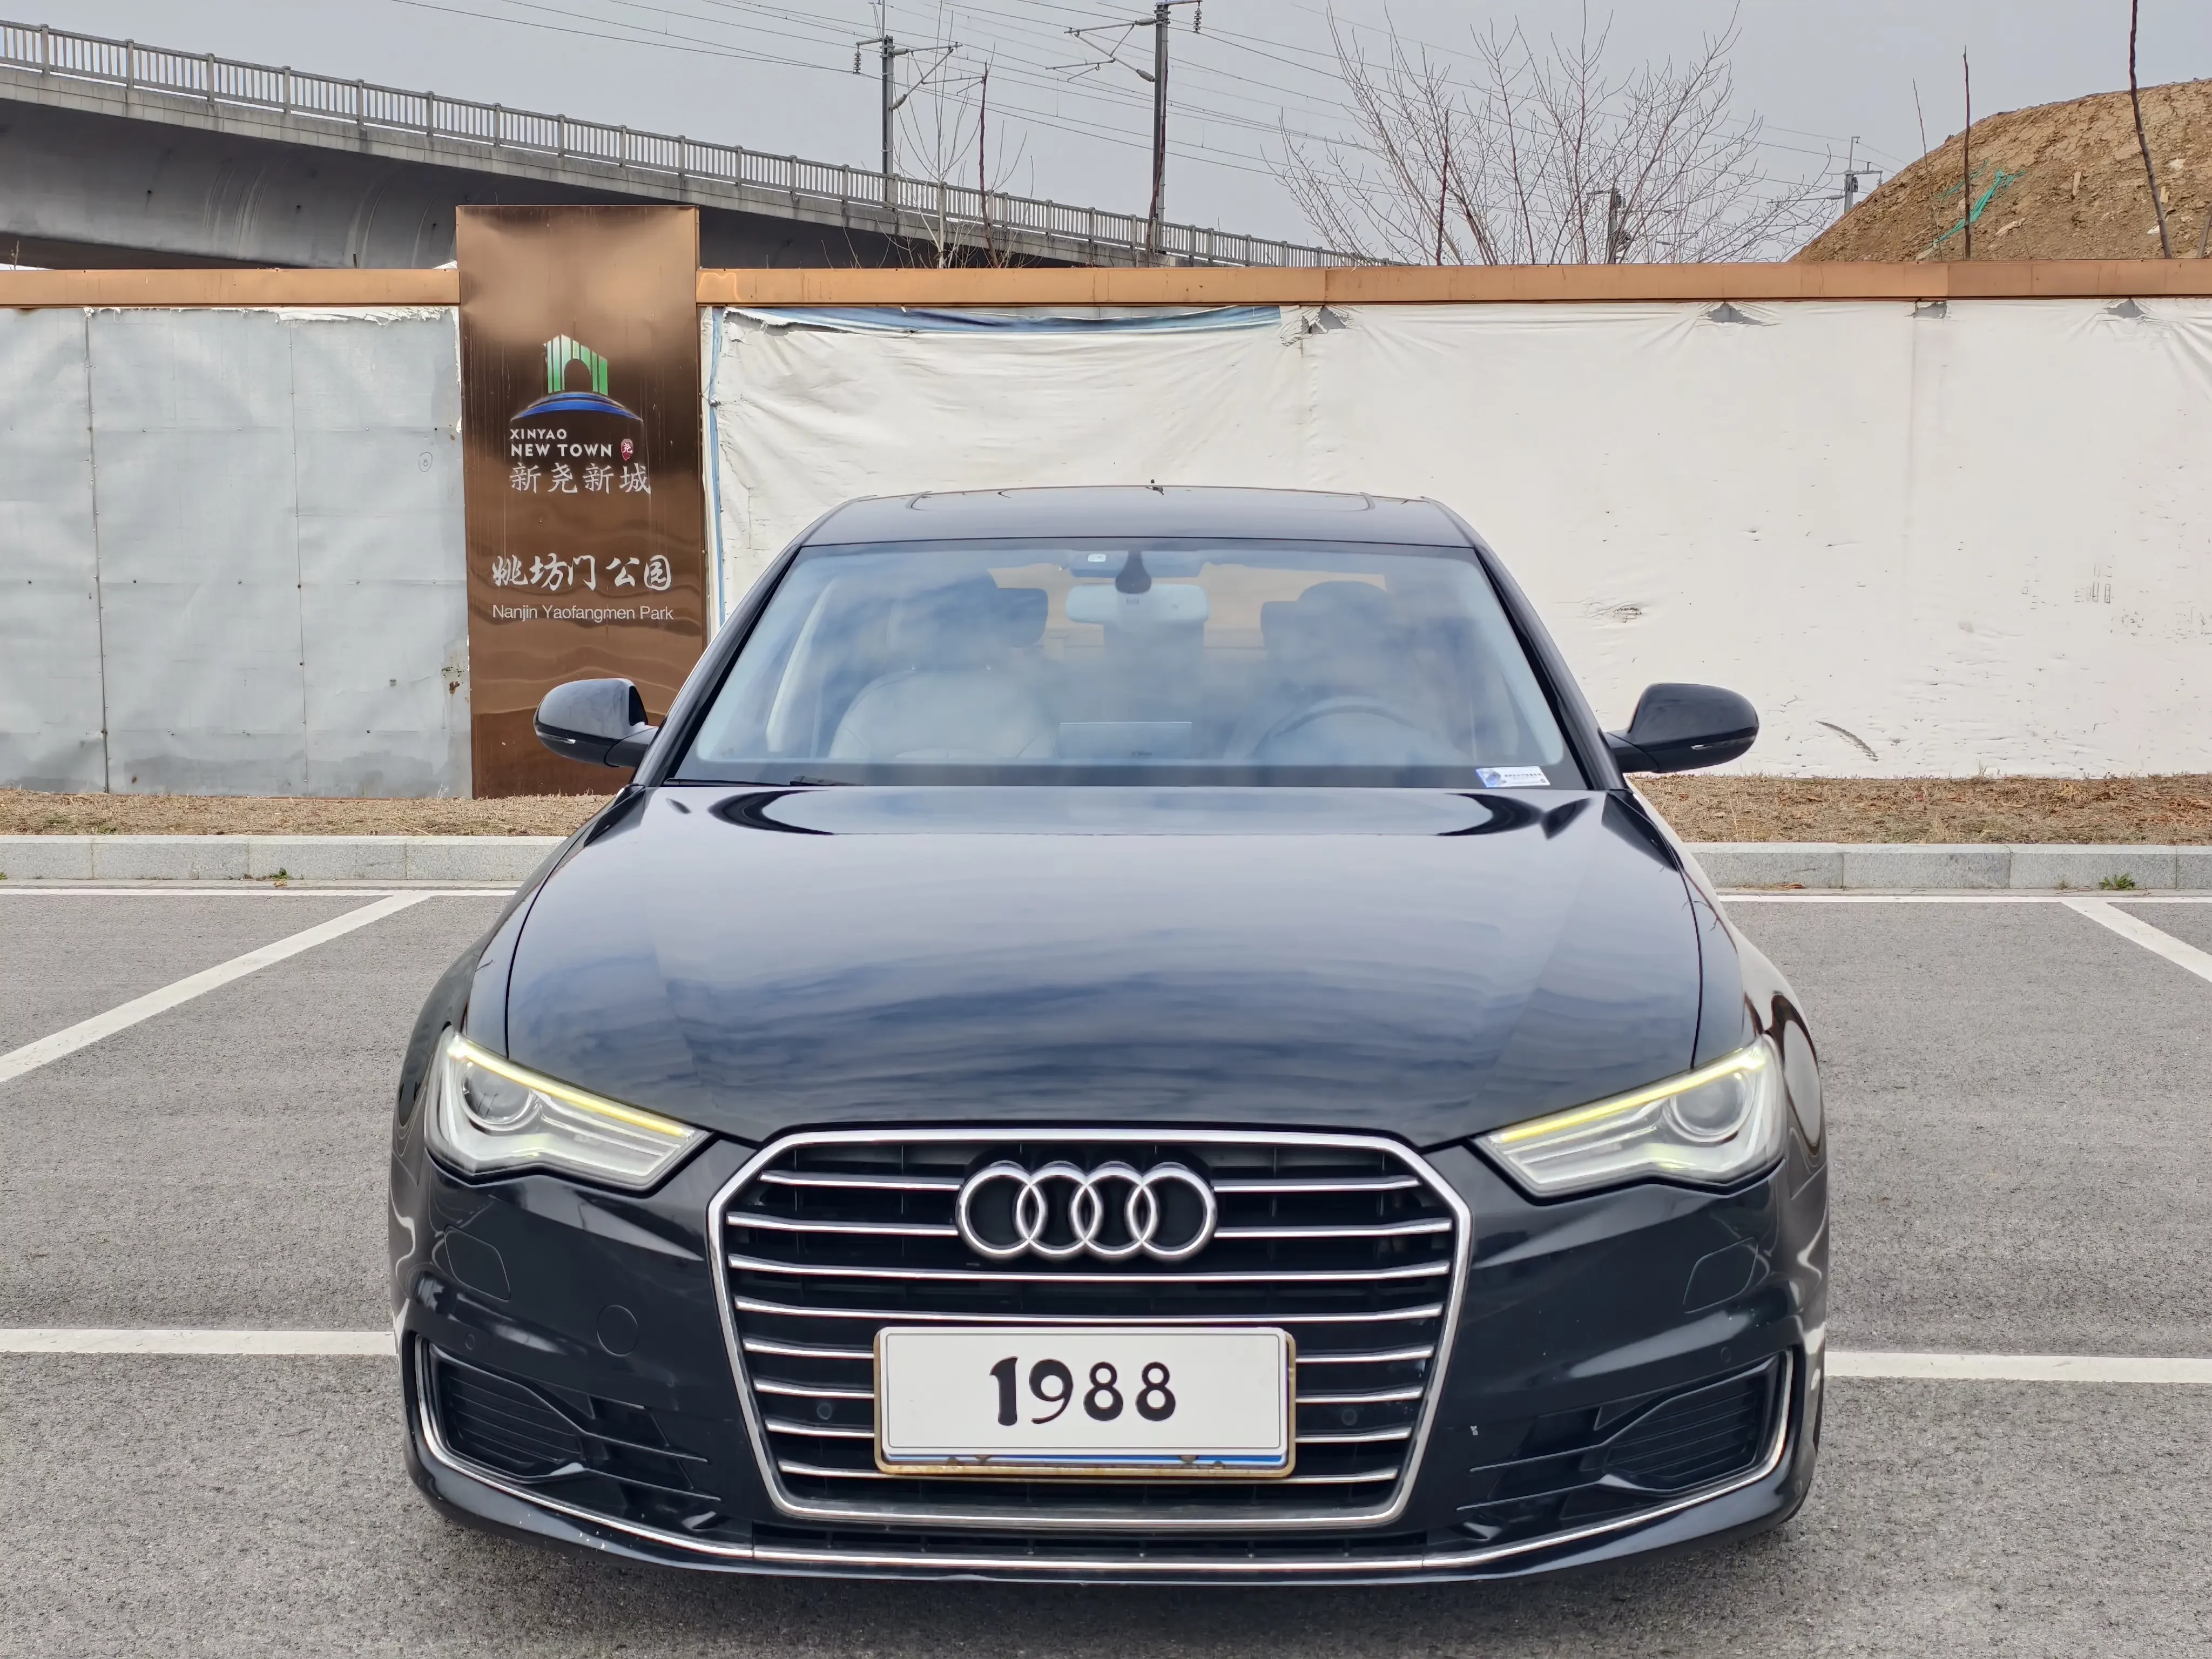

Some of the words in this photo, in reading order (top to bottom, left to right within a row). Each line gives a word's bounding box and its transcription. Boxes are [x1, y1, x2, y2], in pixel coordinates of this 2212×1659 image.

[509, 429, 567, 440] XINYAO
[511, 443, 550, 457] NEW
[557, 444, 612, 457] TOWN
[509, 462, 651, 495] 新尧新城
[492, 552, 671, 591] 姚坊门公园
[493, 604, 537, 622] Nanjin
[542, 605, 635, 623] Yaofangmen
[639, 606, 674, 620] Park
[989, 1356, 1176, 1427] 1988
